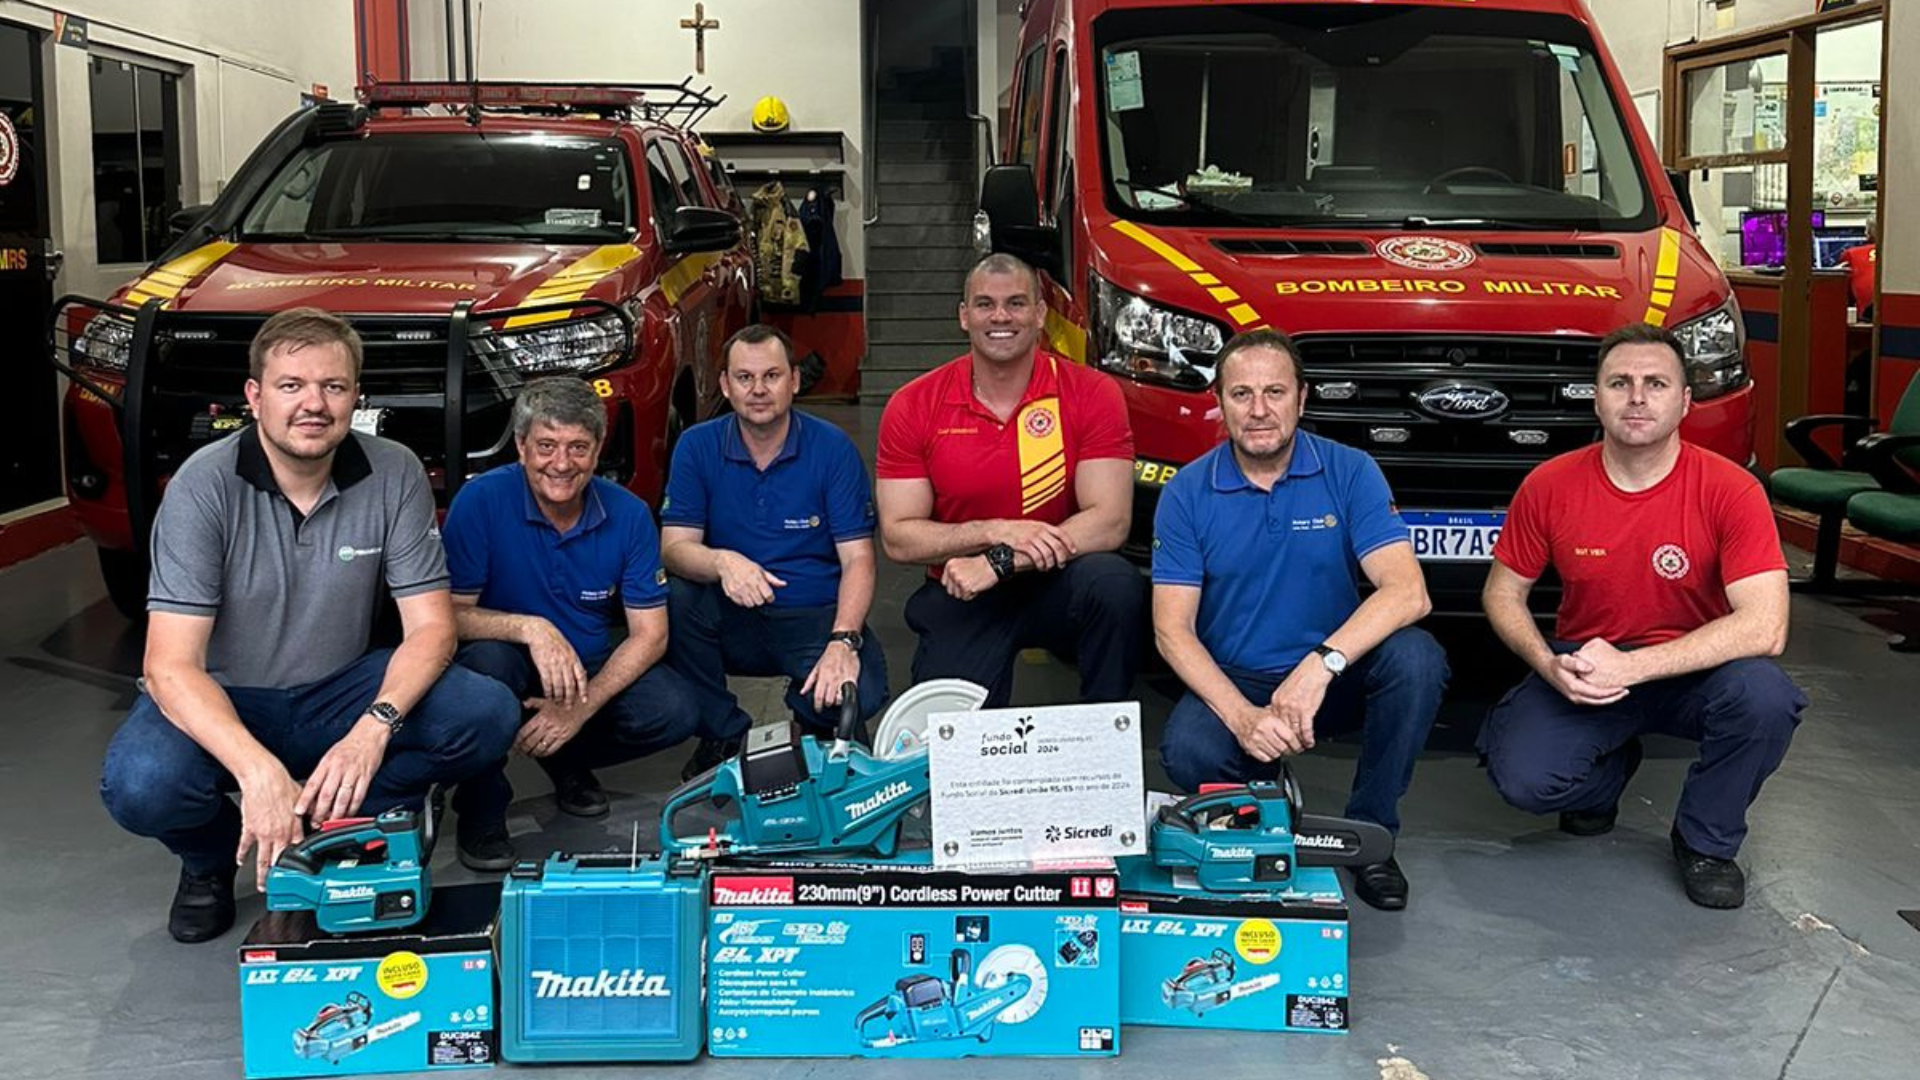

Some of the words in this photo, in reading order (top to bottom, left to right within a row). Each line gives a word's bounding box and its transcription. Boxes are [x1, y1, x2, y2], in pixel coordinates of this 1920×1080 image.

[226, 277, 368, 292] BOMBEIRO
[373, 277, 478, 291] MILITAR
[1275, 278, 1467, 295] BOMBEIRO
[1481, 279, 1623, 300] MILITAR
[593, 378, 614, 398] 8
[1439, 389, 1492, 412] Ford
[1407, 528, 1500, 556] BR7A9
[980, 732, 1012, 745] fundo
[980, 742, 1028, 756] social
[1036, 744, 1060, 754] 2024
[950, 780, 968, 788] Esta
[1078, 773, 1111, 782] recursos
[941, 790, 965, 799] Fundo
[964, 789, 987, 798] Social
[999, 787, 1024, 796] Sicredi
[1063, 824, 1113, 840] Sicredi
[890, 885, 958, 903] Cordless
[960, 886, 1011, 902] Power
[1013, 886, 1062, 902] Cutter
[1190, 922, 1229, 937] XPT
[755, 946, 801, 963] XPT
[322, 965, 364, 982] XPT
[718, 969, 754, 978] Cordless
[755, 970, 781, 978] Power
[782, 970, 807, 978] Cutter
[759, 989, 770, 997] de
[771, 989, 808, 997] Concreto
